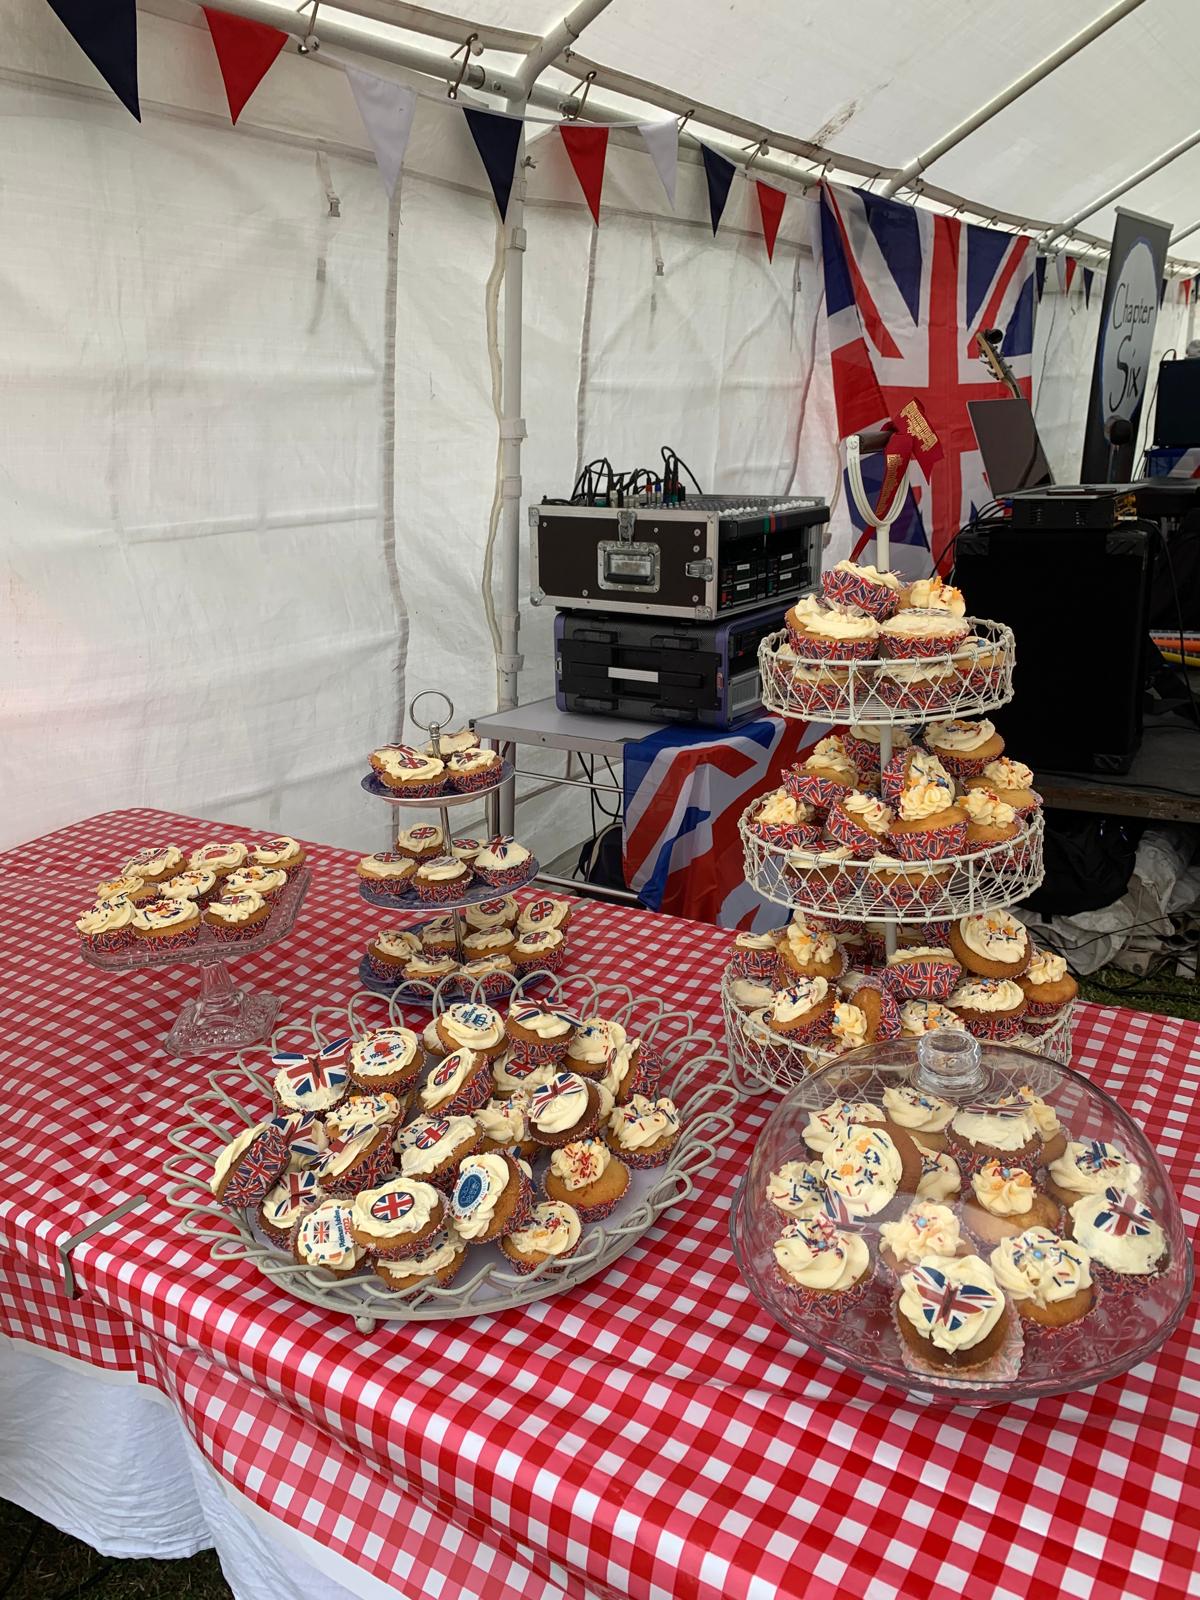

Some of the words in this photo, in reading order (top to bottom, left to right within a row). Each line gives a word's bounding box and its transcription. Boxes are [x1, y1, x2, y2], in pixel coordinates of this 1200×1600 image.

[1113, 283, 1154, 336] Chapter
[1109, 335, 1142, 413] Six
[338, 1226, 346, 1247] Platinum
